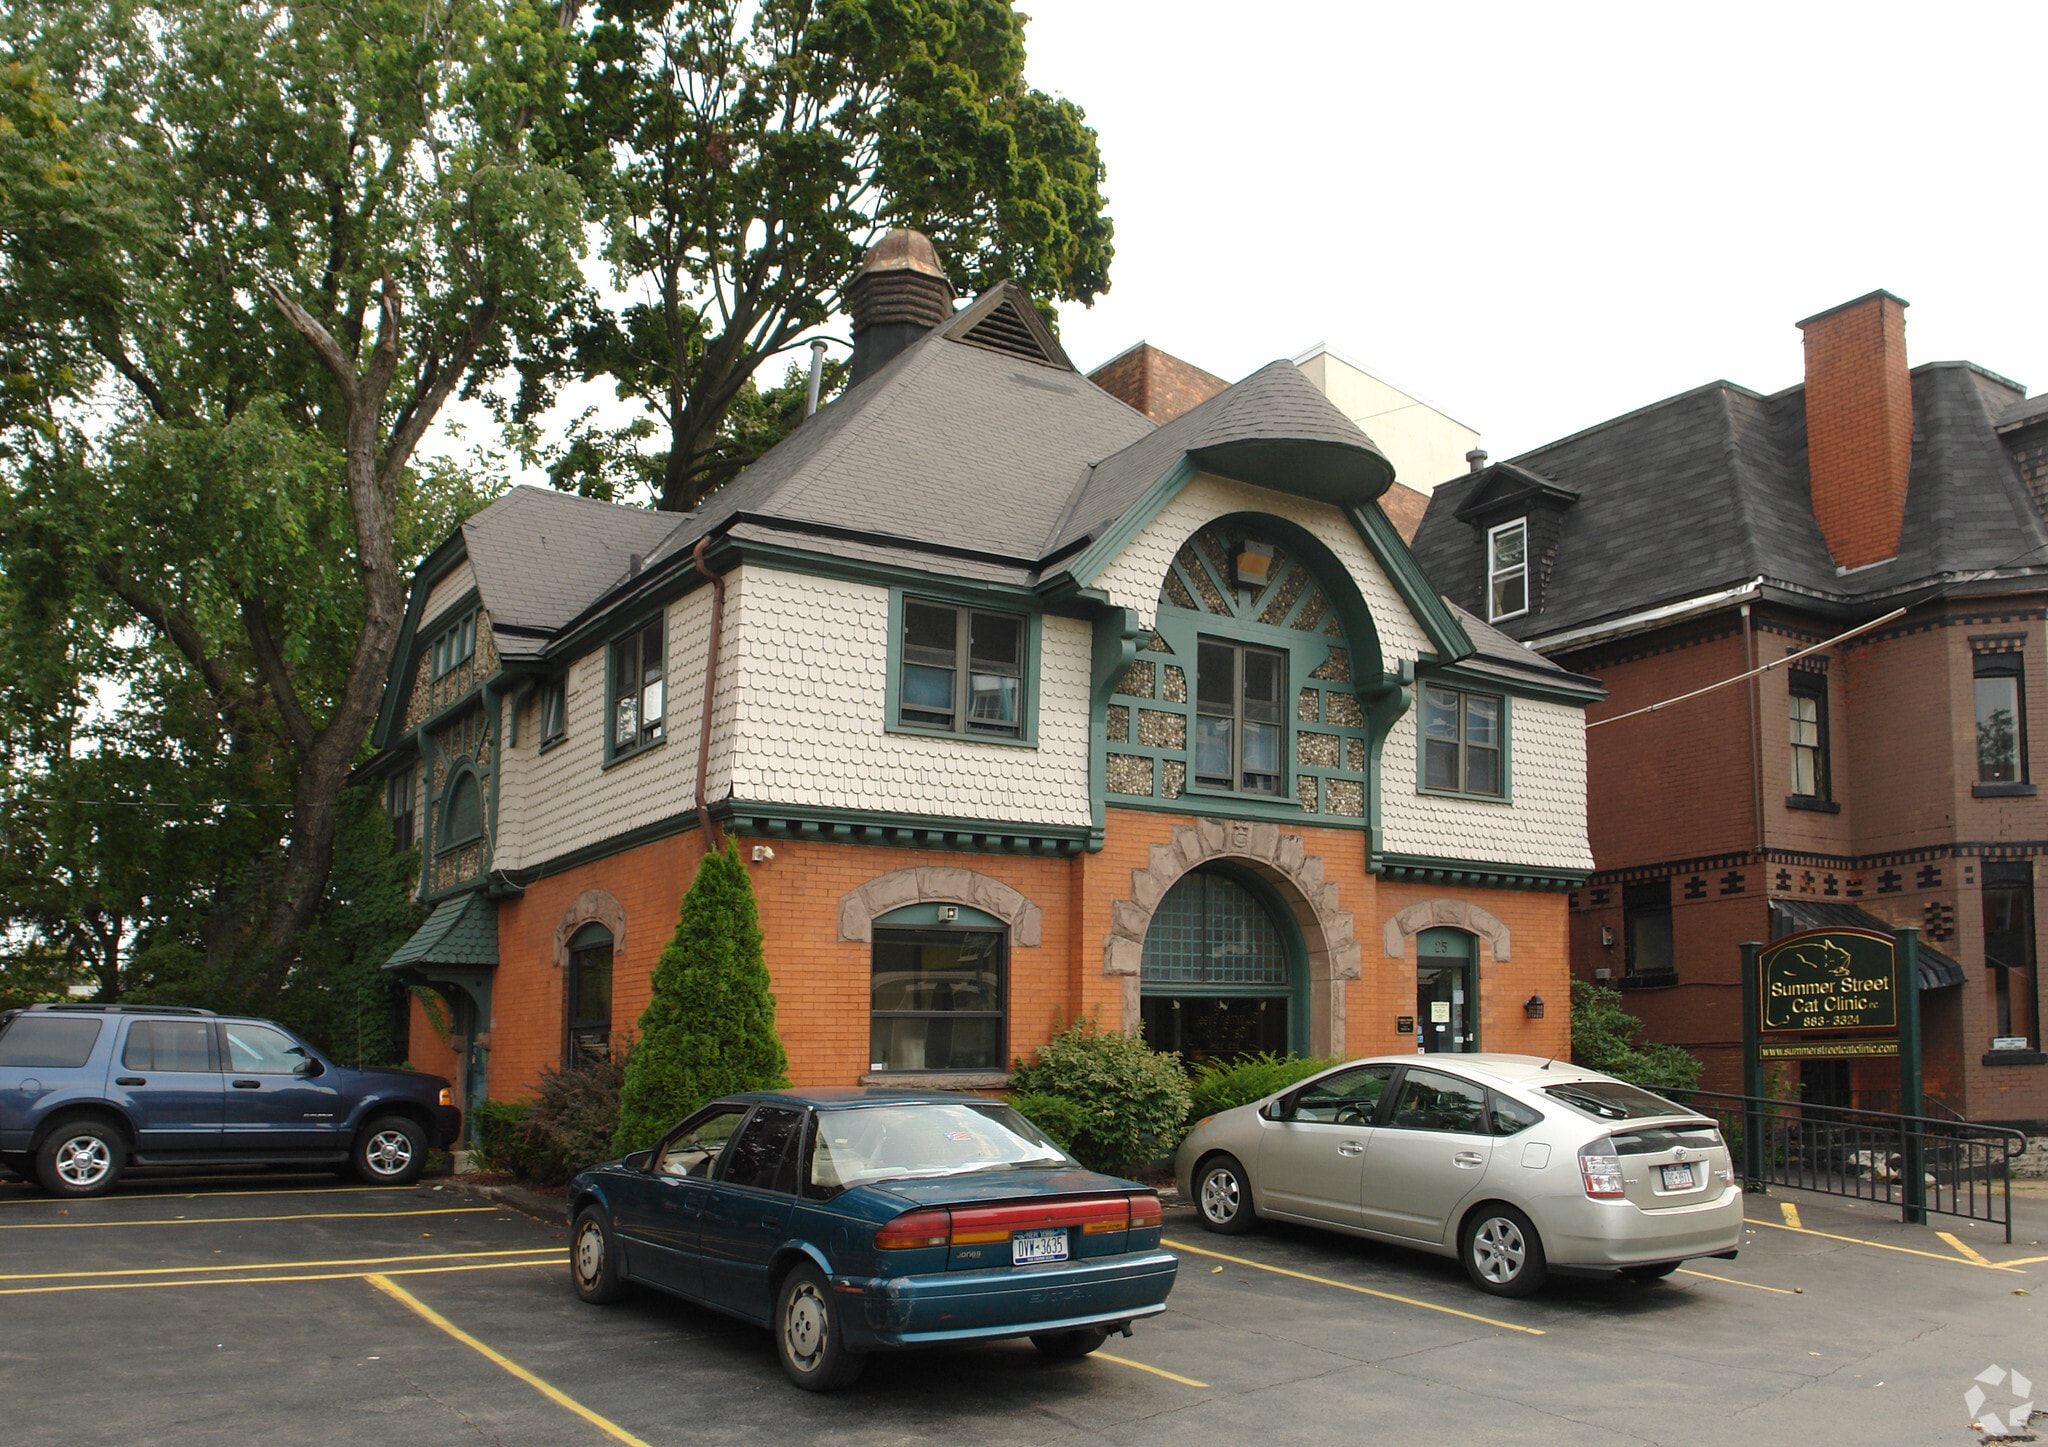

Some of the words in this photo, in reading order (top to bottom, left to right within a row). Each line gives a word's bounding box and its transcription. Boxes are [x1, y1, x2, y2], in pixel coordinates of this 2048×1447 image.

[1771, 981, 1836, 997] Summer
[1840, 976, 1889, 993] Street
[1792, 998, 1819, 1014] Cat
[1824, 995, 1868, 1012] Clinic
[1762, 1043, 1898, 1056] www.summerstreetcatclinic.com
